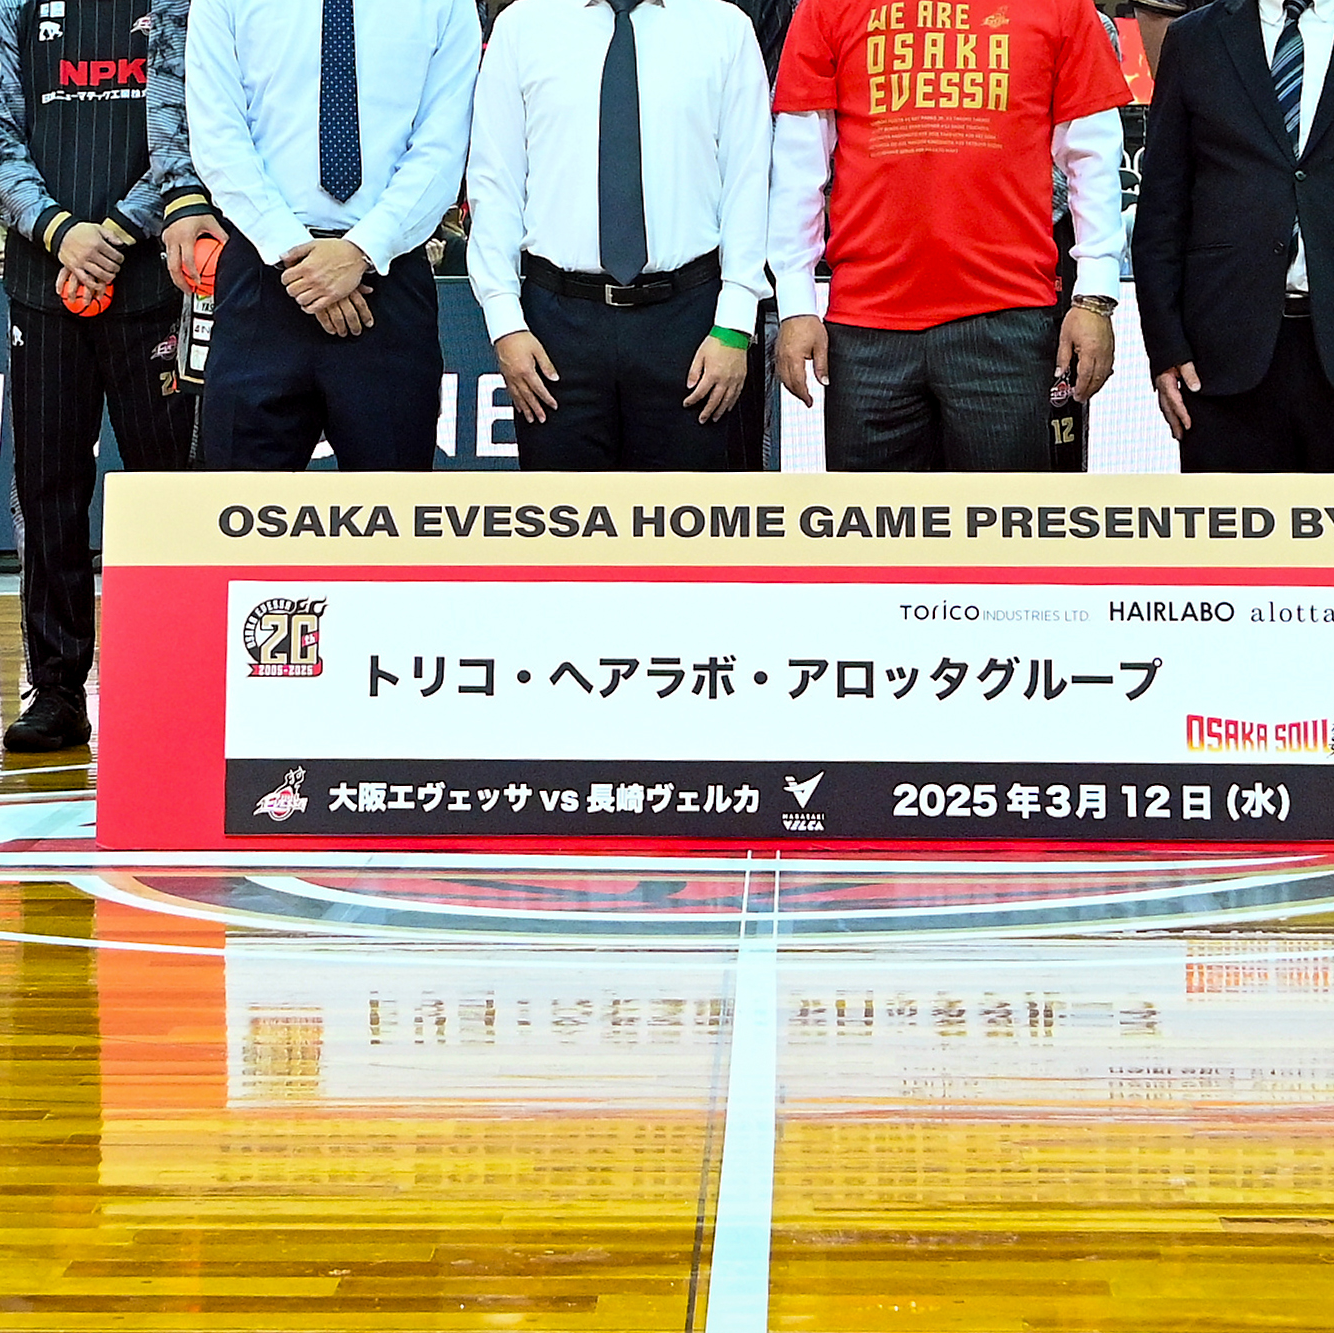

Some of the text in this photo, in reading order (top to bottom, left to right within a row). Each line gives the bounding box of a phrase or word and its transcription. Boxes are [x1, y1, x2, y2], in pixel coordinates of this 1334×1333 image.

[867, 0, 971, 32] WE ARE
[867, 32, 1009, 75] OSAKA
[59, 58, 147, 86] NPK
[868, 72, 1010, 115] EVESSA
[1051, 417, 1075, 445] 12
[218, 505, 400, 538] OSAKA
[413, 505, 618, 538] EVESSA
[632, 505, 786, 538] HOME
[799, 506, 951, 538] GAME
[967, 506, 1276, 539] PRESENTED
[983, 609, 1060, 622] INDUSTRIES
[1109, 601, 1235, 622] HAIRLABO
[369, 654, 1163, 701] トリコ・ヘアラボ・アロッタグループ
[1186, 714, 1334, 753] OSAKA SOUL
[328, 781, 761, 815] 大阪エヴェッサ vs 長崎ヴェルカ
